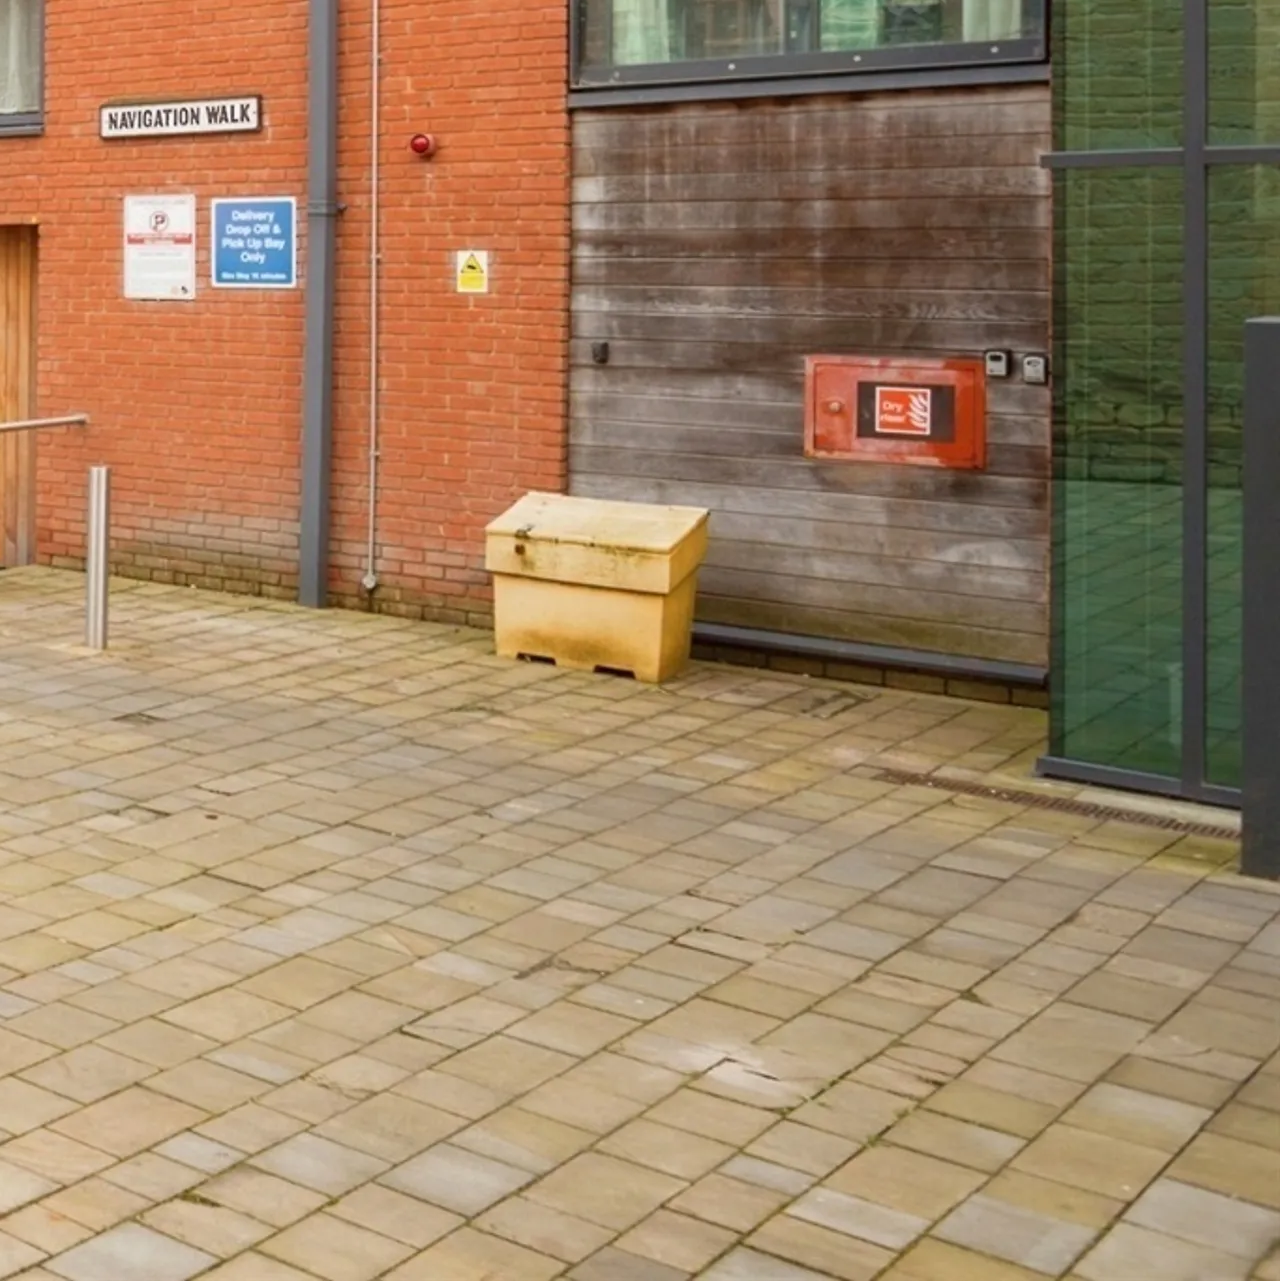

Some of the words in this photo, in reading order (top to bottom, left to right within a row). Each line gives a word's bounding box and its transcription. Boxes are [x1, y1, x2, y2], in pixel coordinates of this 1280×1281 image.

[108, 107, 201, 130] NAVIGATION
[206, 104, 251, 124] WALK
[231, 209, 275, 223] Delivery
[225, 223, 252, 236] Drop
[253, 223, 271, 235] Off
[272, 223, 281, 234] &
[221, 237, 244, 249] Pick
[246, 237, 263, 250] Up
[263, 237, 286, 251] Bay
[240, 251, 266, 265] Only
[882, 400, 904, 414] Dry
